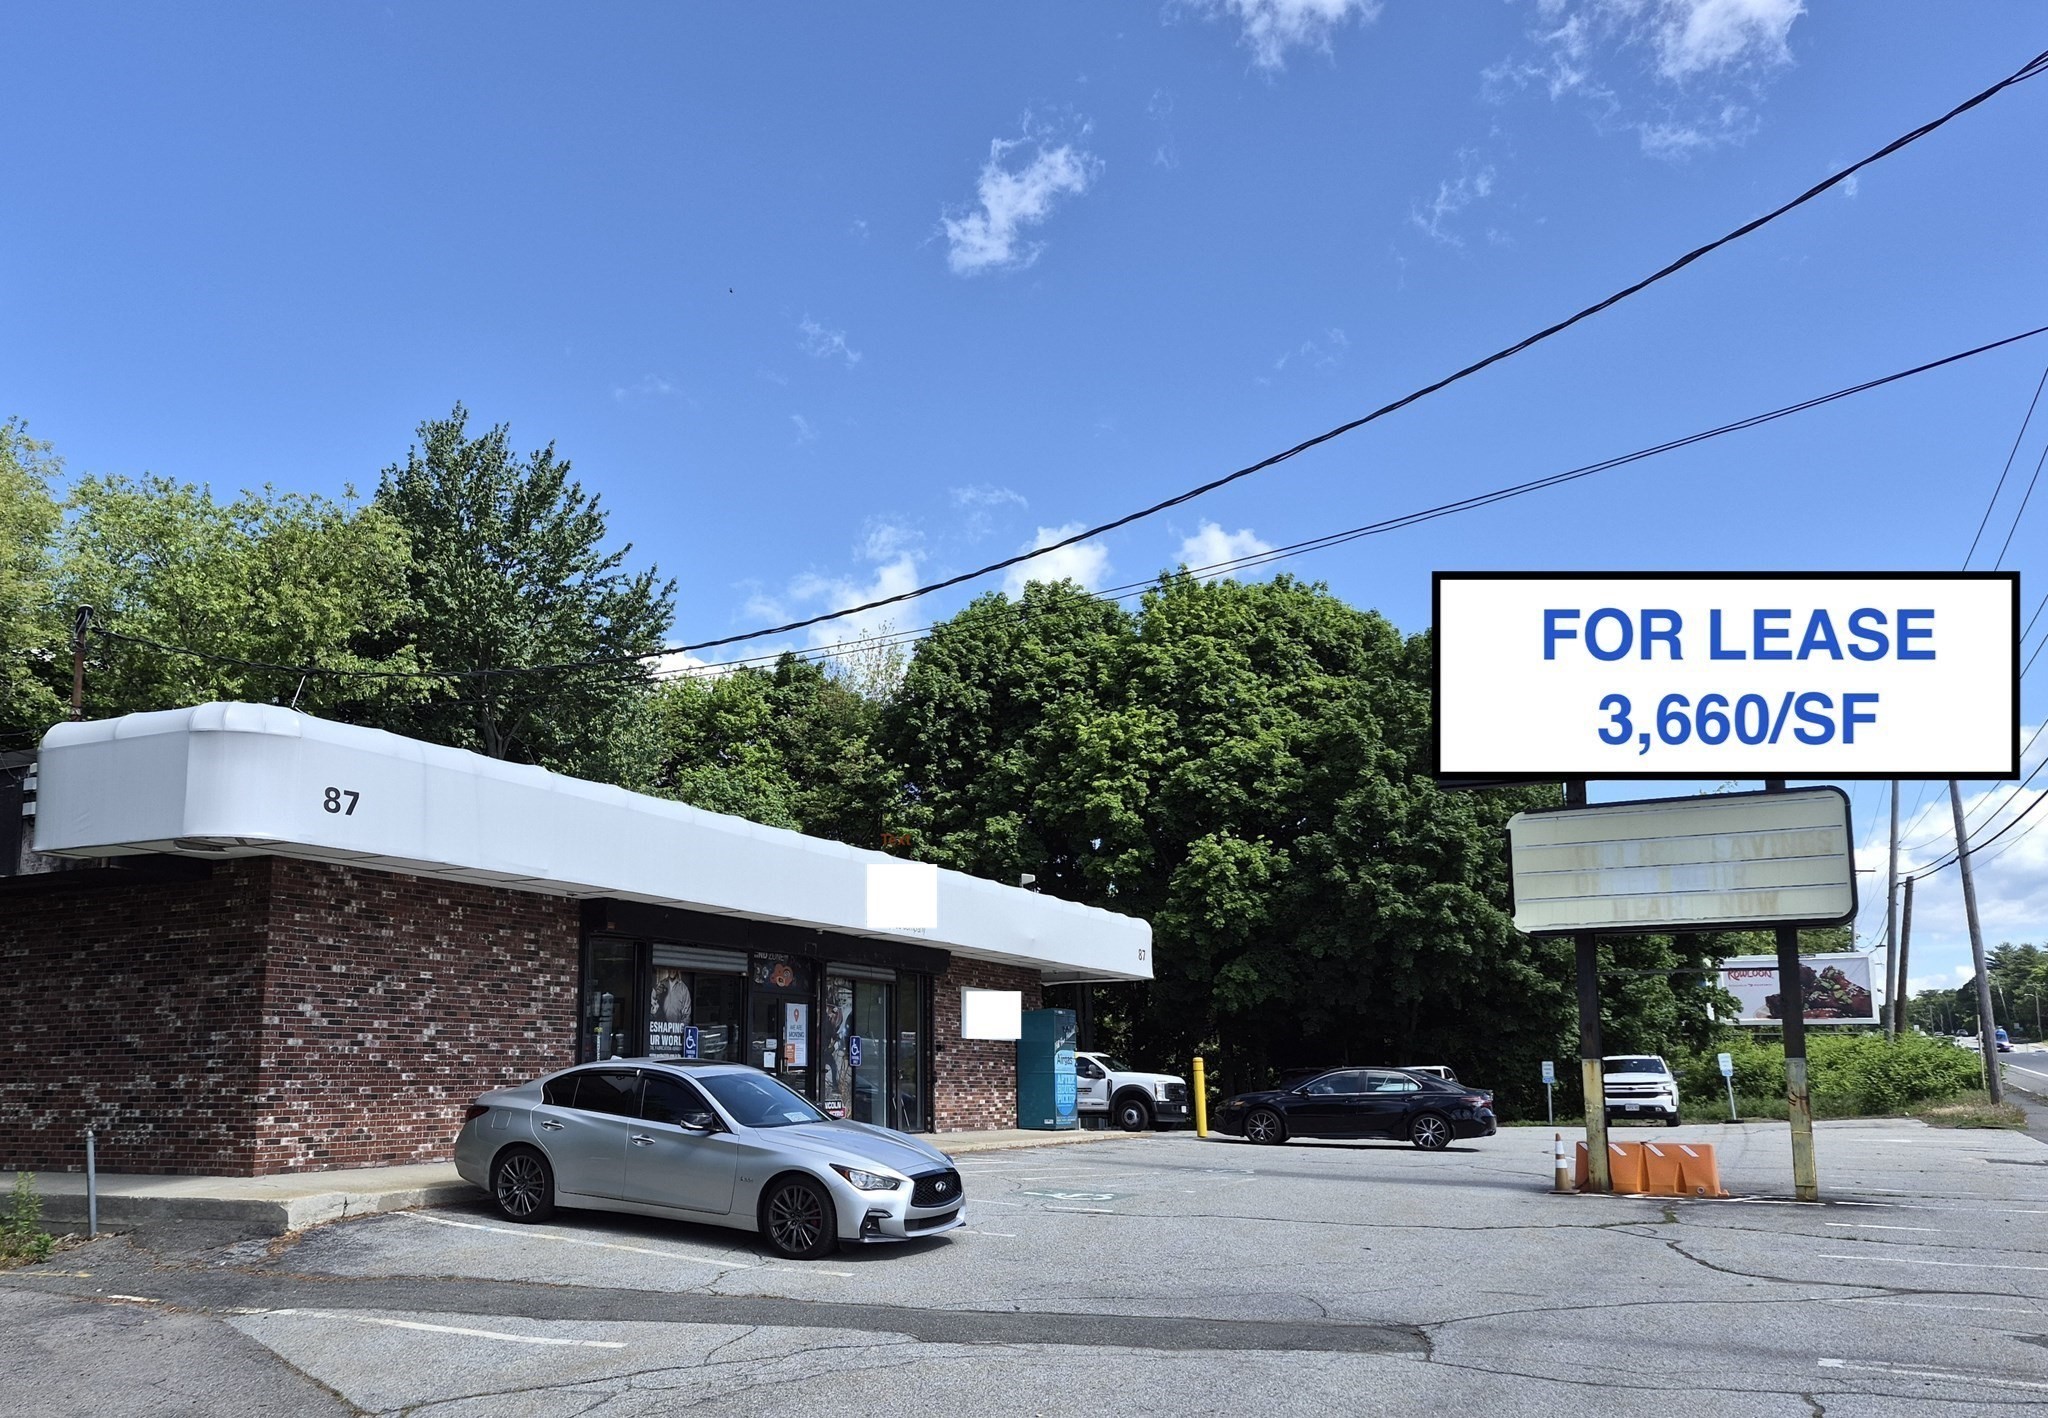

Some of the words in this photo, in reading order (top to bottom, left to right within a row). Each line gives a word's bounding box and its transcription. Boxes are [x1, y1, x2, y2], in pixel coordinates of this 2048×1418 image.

[323, 786, 360, 816] 87
[1138, 948, 1146, 961] 87
[1727, 967, 1772, 981] KOWLOON
[649, 1034, 660, 1046] UR
[1056, 1053, 1073, 1066] Airgas
